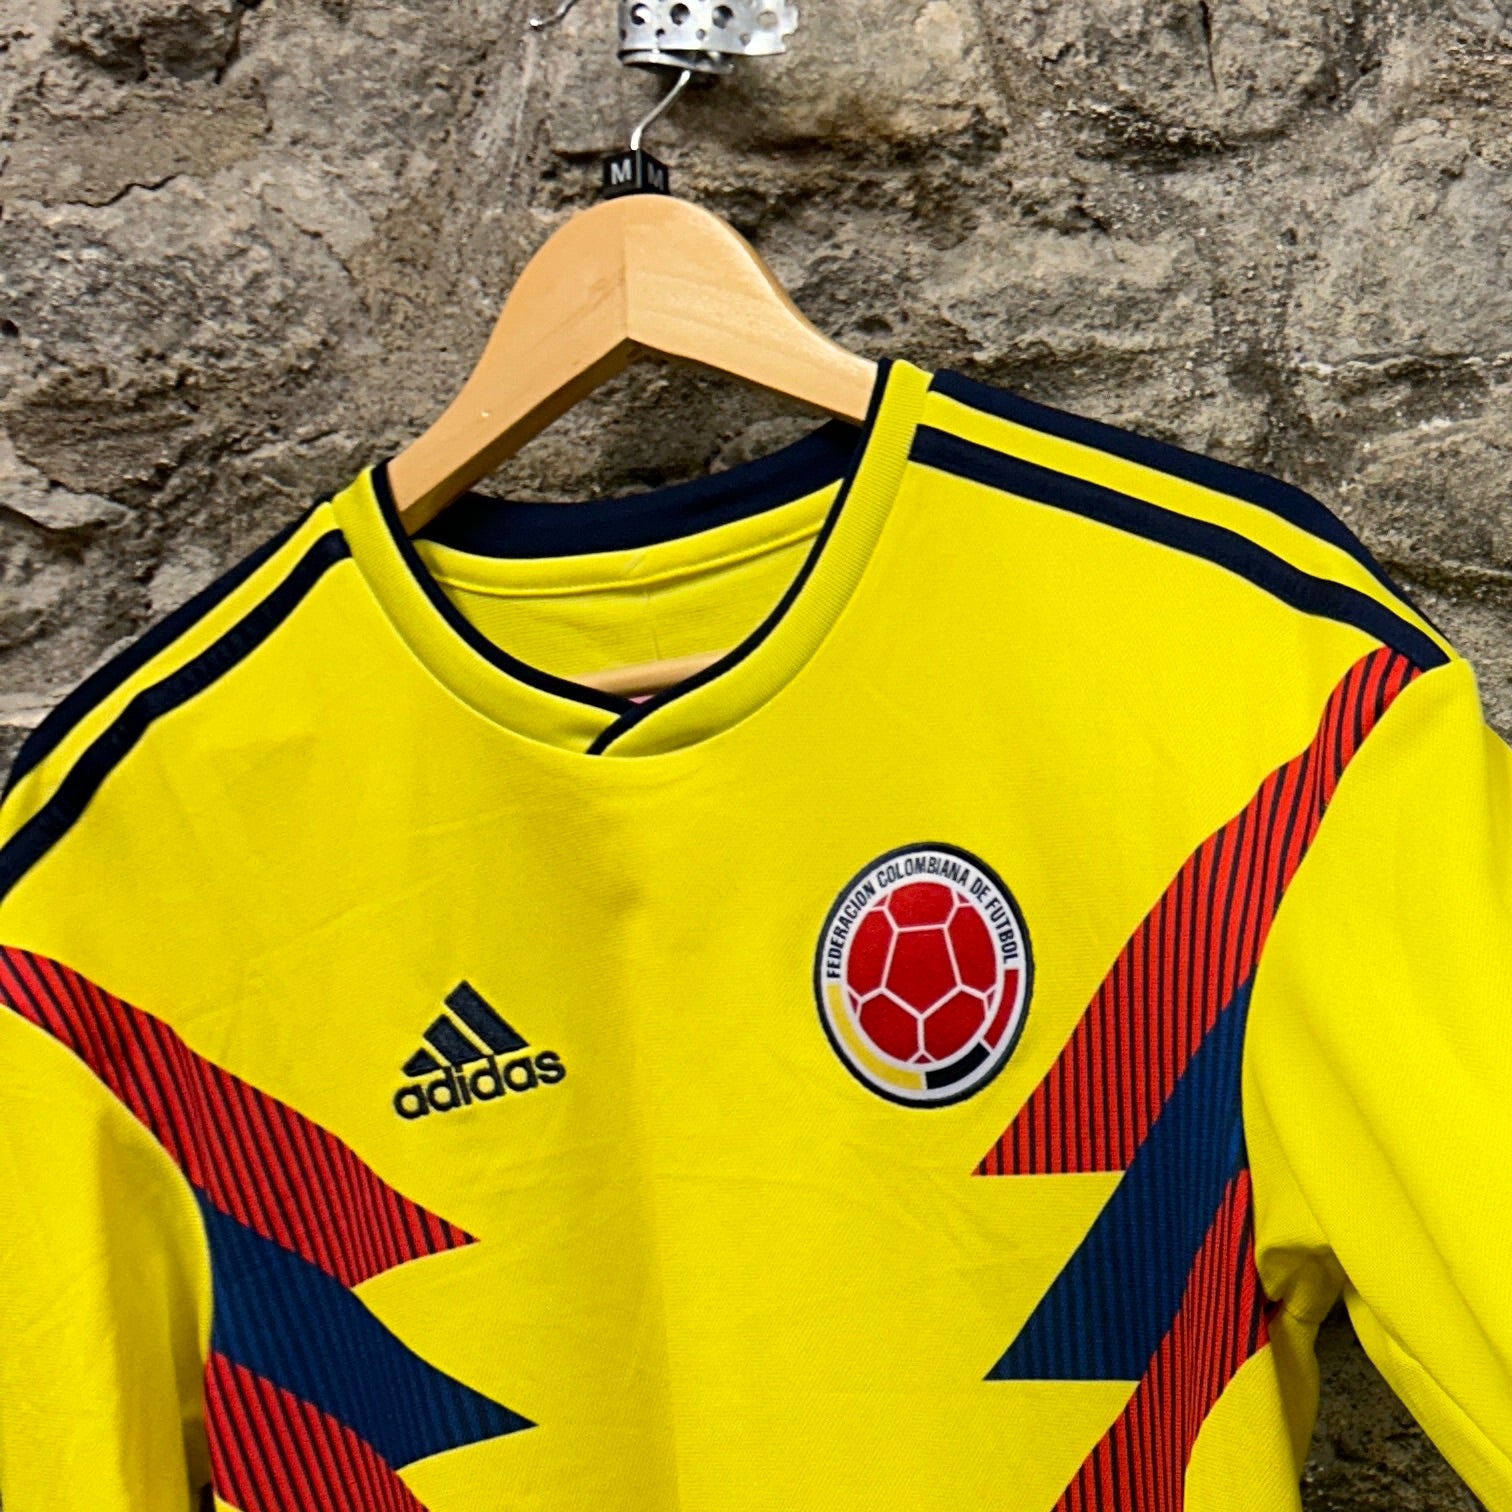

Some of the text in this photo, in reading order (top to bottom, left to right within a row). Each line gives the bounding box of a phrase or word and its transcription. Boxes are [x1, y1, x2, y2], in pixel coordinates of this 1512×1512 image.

[611, 158, 632, 185] M
[648, 162, 664, 191] M
[826, 856, 1019, 979] FEDERACION COLOMBIANA DE FUTBOL
[393, 1051, 566, 1120] adidas
